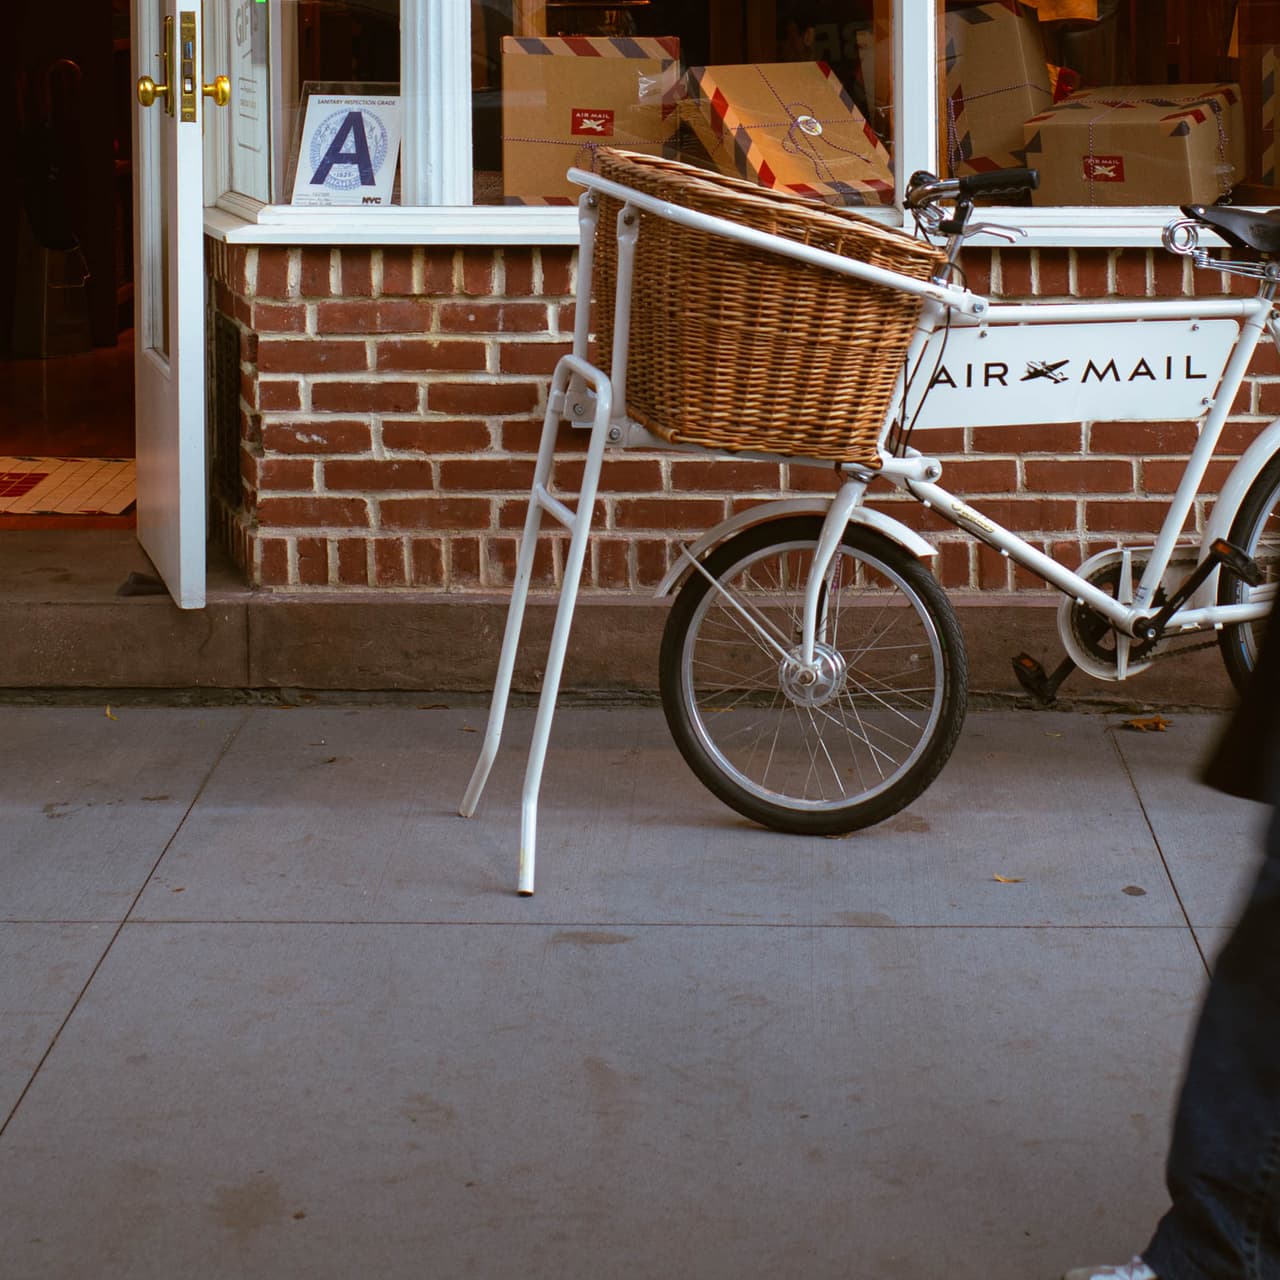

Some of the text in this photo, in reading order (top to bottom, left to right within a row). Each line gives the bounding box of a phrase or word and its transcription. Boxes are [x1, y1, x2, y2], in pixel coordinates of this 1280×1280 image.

[309, 111, 376, 187] A
[361, 196, 382, 205] NYC
[928, 355, 1207, 389] AIR MAIL
